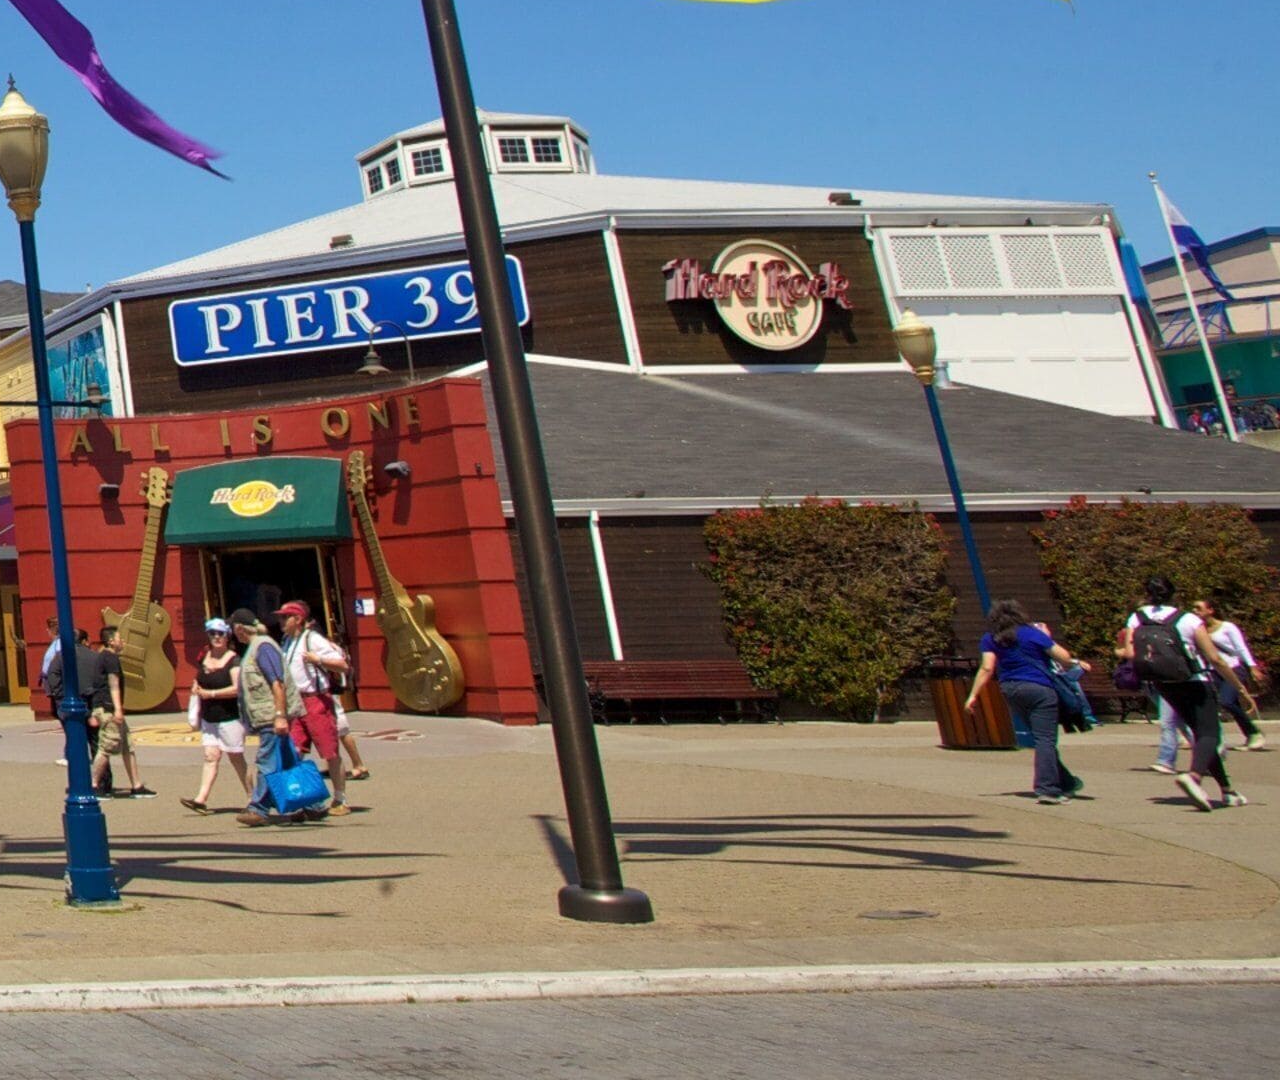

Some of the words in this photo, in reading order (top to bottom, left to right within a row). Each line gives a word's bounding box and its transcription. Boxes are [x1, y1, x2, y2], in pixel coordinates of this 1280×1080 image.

[662, 258, 757, 302] Hard
[762, 258, 855, 309] Rock
[197, 285, 382, 355] PIER
[404, 270, 480, 330] 39
[70, 424, 170, 454] ALL
[219, 416, 274, 447] IS
[319, 395, 421, 438] ONE
[210, 488, 252, 504] Hard
[255, 484, 295, 503] Rock
